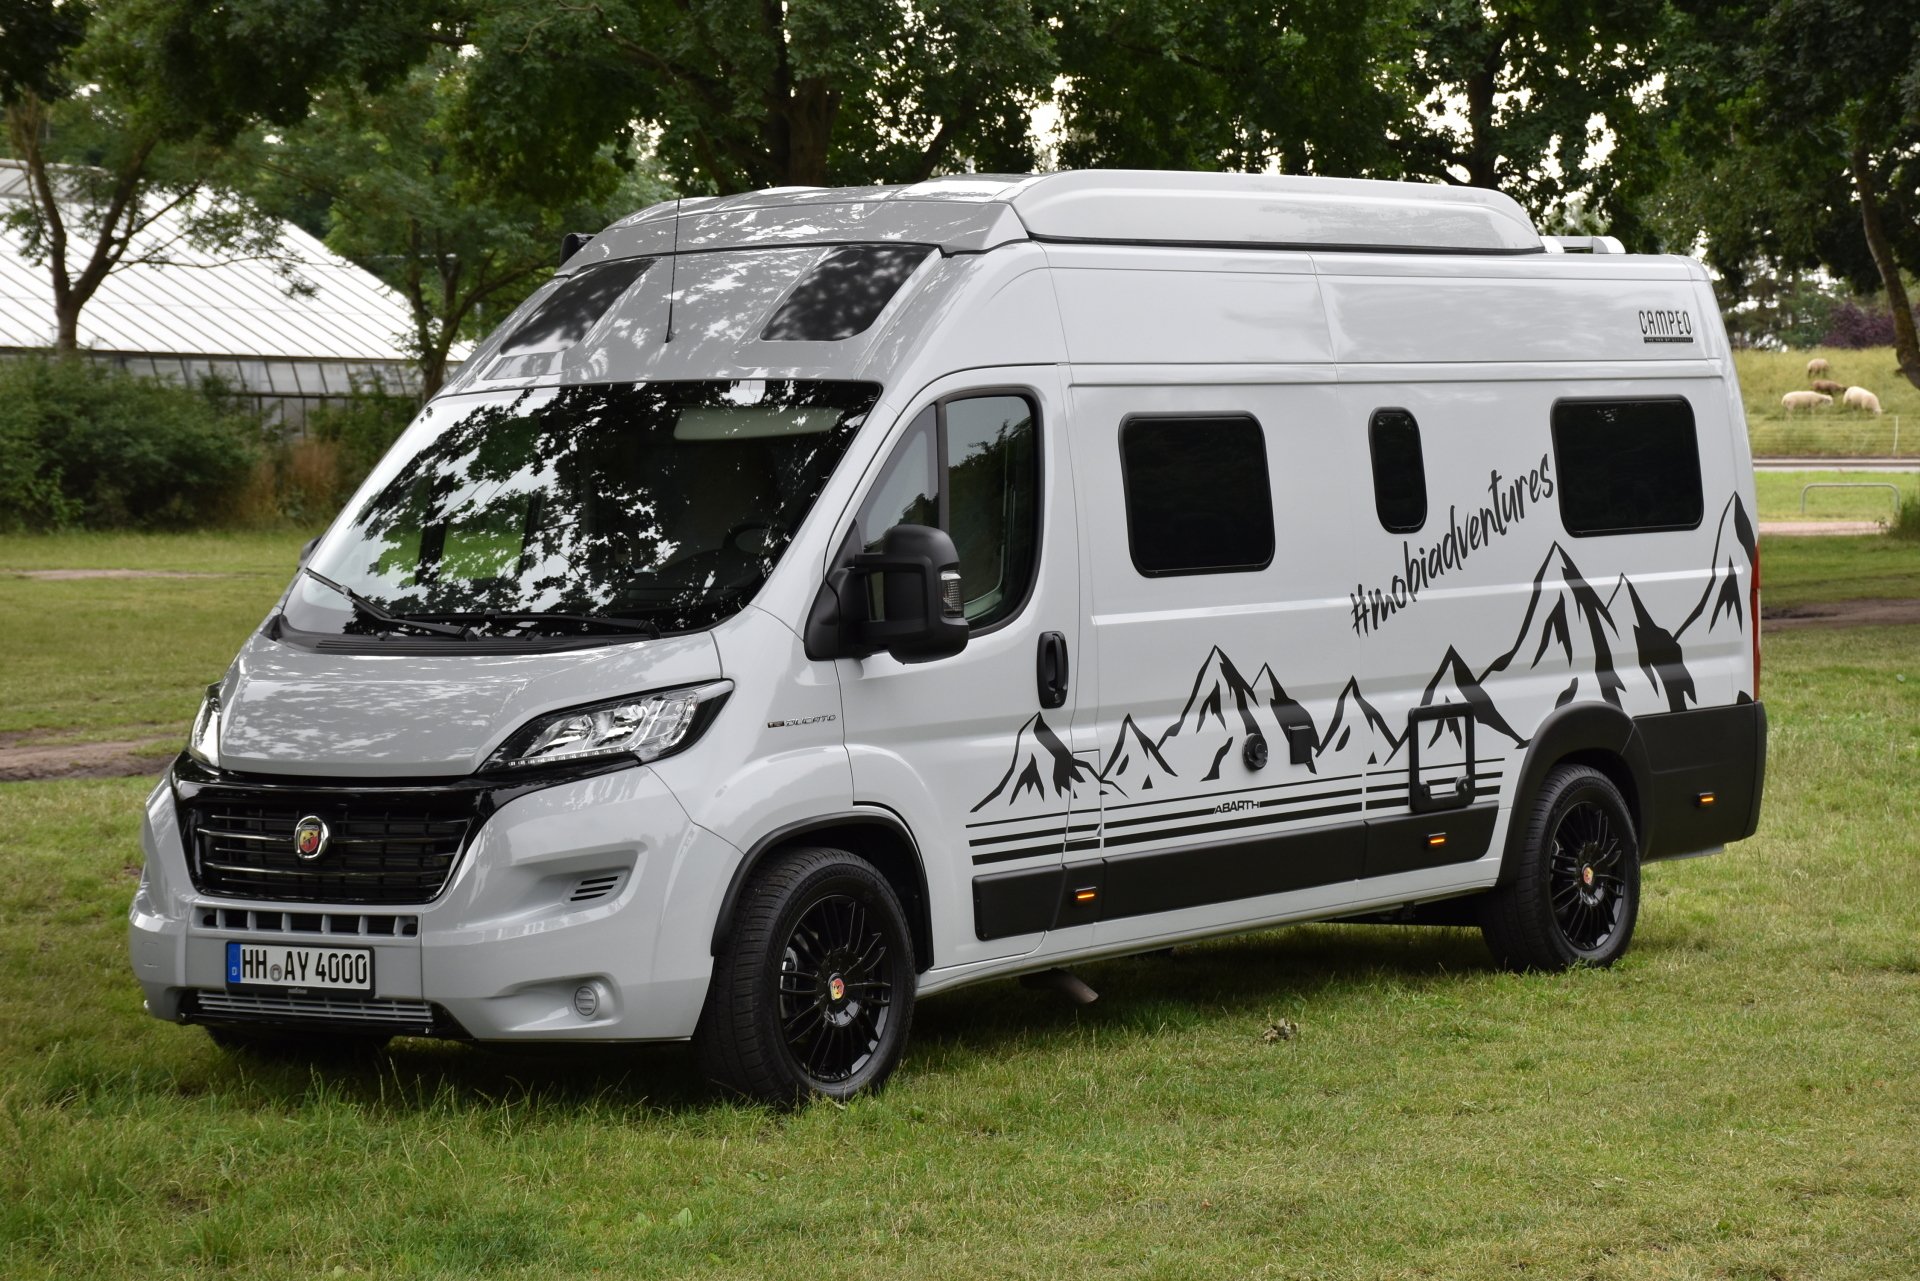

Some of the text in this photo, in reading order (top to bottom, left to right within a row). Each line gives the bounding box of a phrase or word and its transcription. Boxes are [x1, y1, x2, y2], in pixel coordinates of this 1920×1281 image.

[1638, 310, 1692, 335] CAMPEO
[1350, 453, 1554, 638] #mobiadventures
[1214, 800, 1260, 814] ABARTH
[242, 949, 368, 985] HH AY 4000
